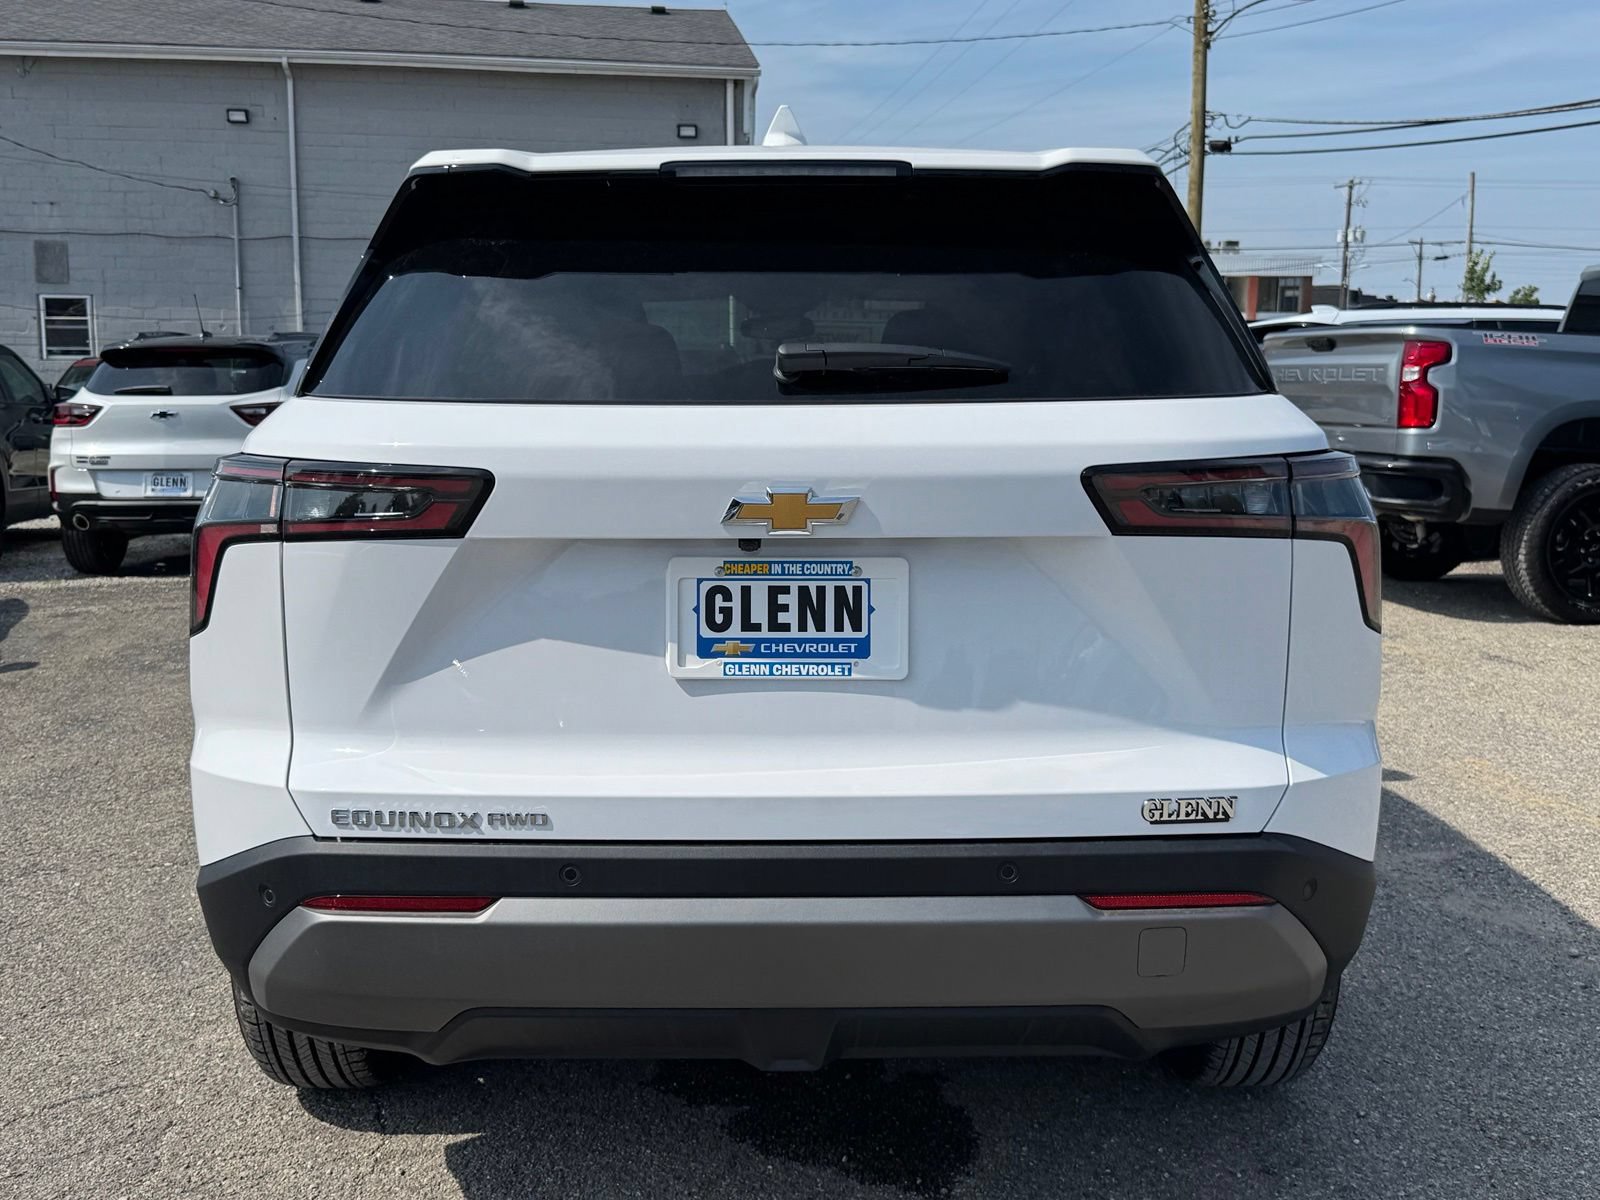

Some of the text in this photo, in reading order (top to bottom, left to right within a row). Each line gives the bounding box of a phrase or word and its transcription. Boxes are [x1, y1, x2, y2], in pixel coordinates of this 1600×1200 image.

[1279, 367, 1384, 382] HEVROLET
[153, 477, 187, 487] GLENN
[724, 564, 769, 574] CHEAPER
[771, 563, 781, 574] IN
[784, 563, 802, 574] THE
[705, 585, 862, 632] GLENN
[760, 643, 858, 653] CHEVROLET
[725, 664, 851, 676] GLENN CHEVROLET
[1141, 797, 1237, 824] GLENN
[331, 809, 549, 829] EQUINOX AWD
